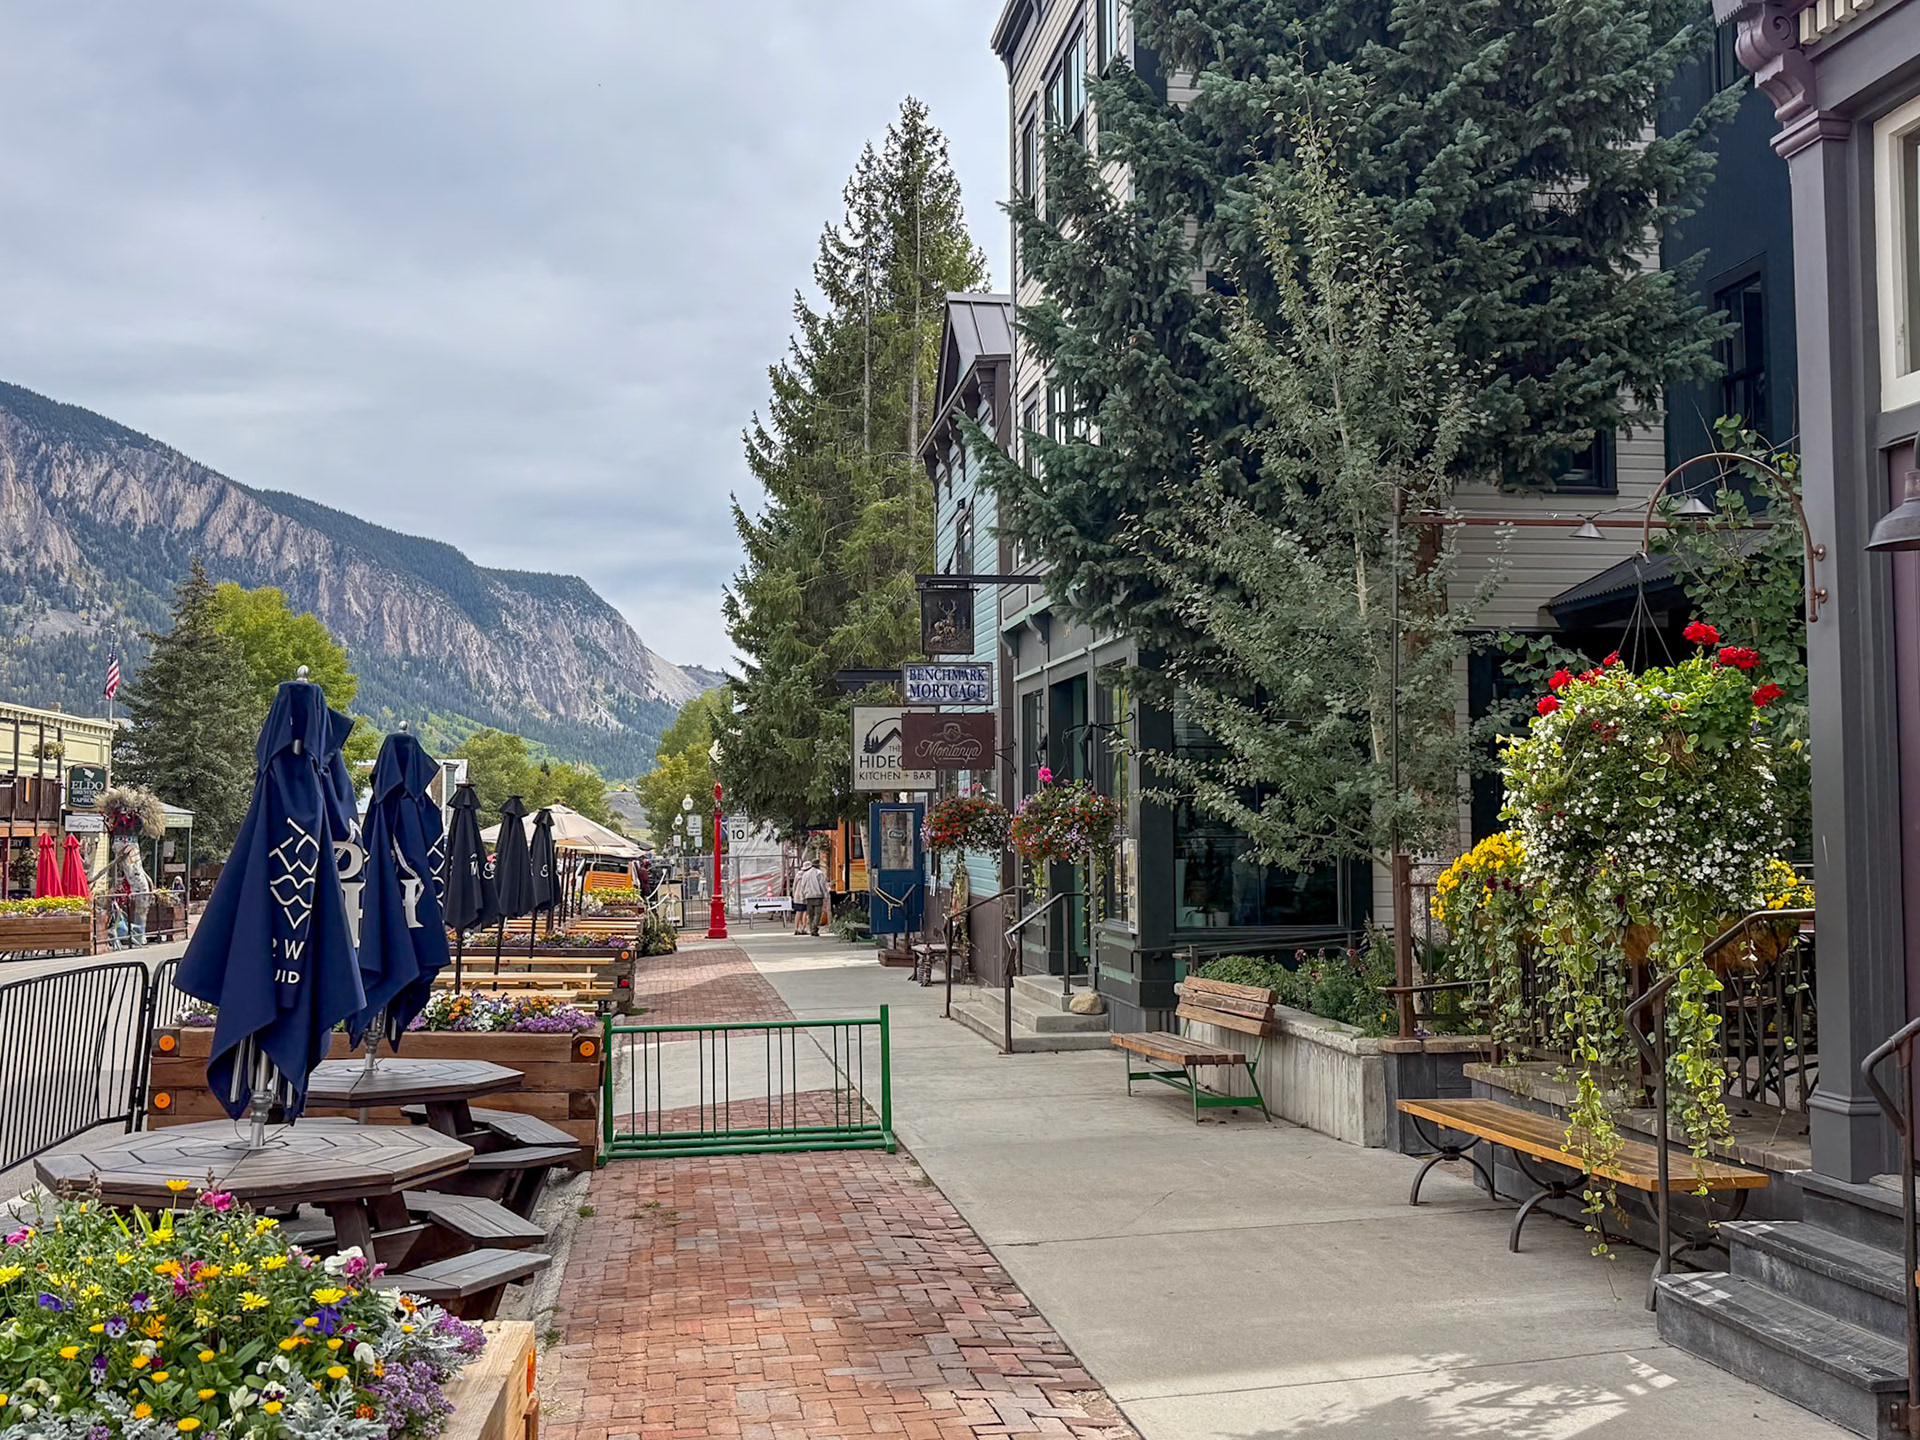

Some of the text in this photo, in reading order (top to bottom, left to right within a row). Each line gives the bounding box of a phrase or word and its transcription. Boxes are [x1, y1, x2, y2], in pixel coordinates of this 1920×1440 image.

[909, 668, 985, 681] BENCHMARK
[909, 684, 986, 698] MORTGAGE
[915, 738, 982, 764] Montanya
[859, 772, 901, 780] KITCHEN
[913, 771, 932, 780] BAR
[71, 780, 104, 790] ELDO
[731, 830, 744, 840] 10
